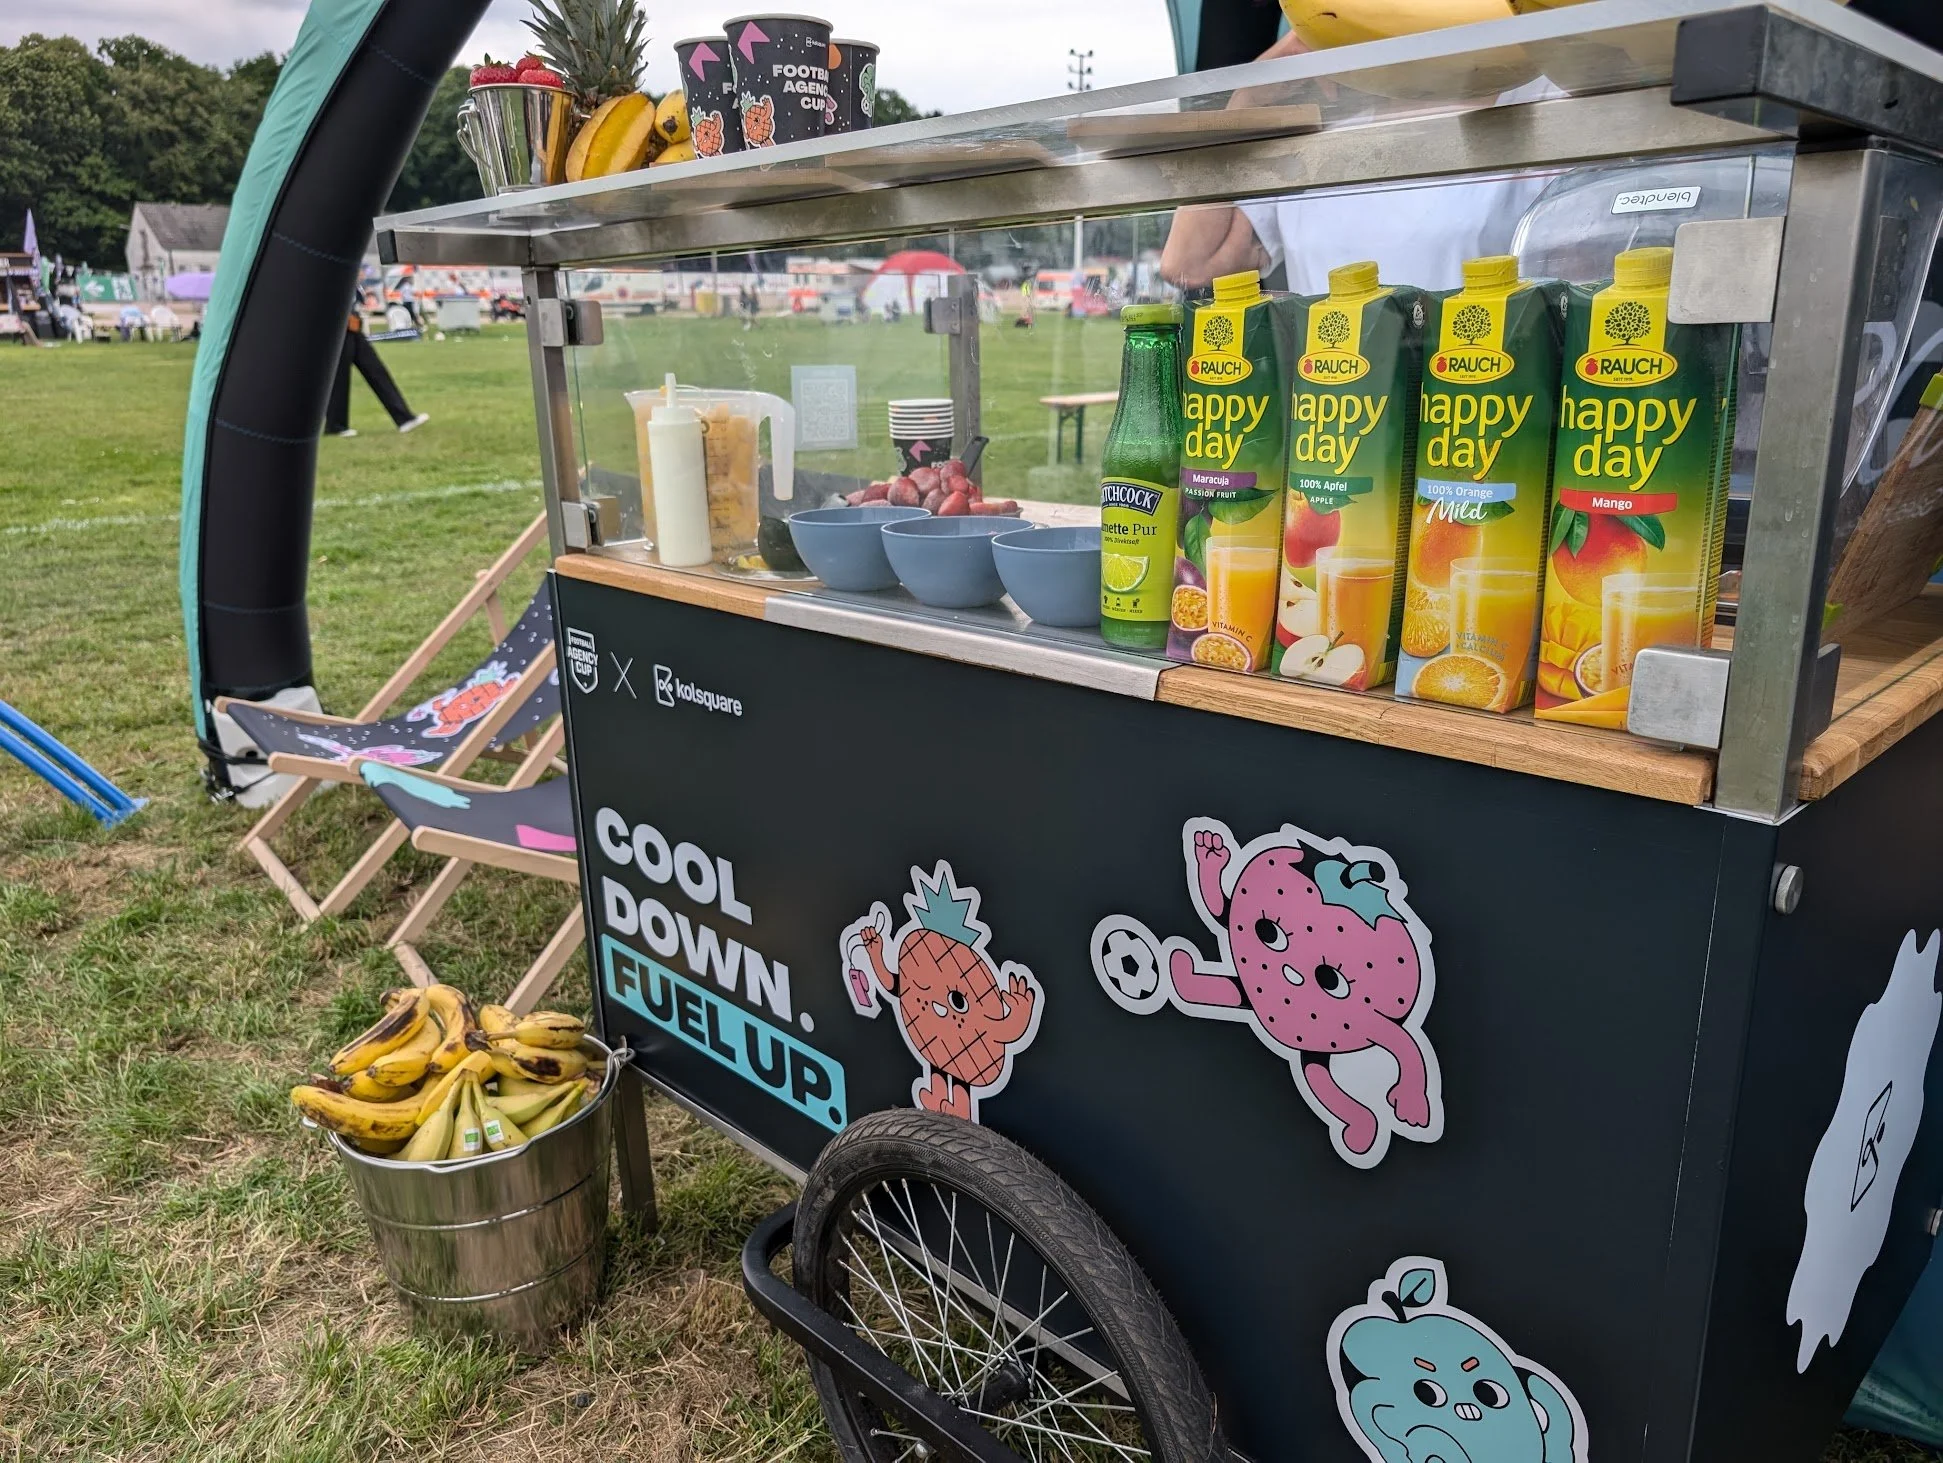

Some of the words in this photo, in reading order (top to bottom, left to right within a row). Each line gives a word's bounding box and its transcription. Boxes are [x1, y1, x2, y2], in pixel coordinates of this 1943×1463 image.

[800, 96, 827, 112] CUP
[1200, 361, 1242, 376] RAUCH
[1313, 359, 1359, 374] RAUCH
[1448, 356, 1502, 373] RAUCH
[1600, 357, 1663, 375] RAUCH
[1560, 384, 1697, 445] happy
[1185, 422, 1245, 470] day
[1295, 424, 1361, 475] day
[1426, 426, 1503, 481] day
[1573, 433, 1664, 491] day
[1192, 473, 1230, 486] Maracuja
[1299, 479, 1322, 489] 100%
[1323, 480, 1347, 492] Apfel
[1185, 487, 1214, 498] PASSION
[1216, 491, 1237, 499] FRUIT
[1427, 484, 1453, 495] 100%
[1455, 486, 1493, 498] Orange
[1310, 496, 1334, 505] APPLE
[1591, 496, 1633, 511] Mango
[1425, 496, 1488, 525] Mild
[1132, 523, 1158, 536] Pur
[1212, 621, 1246, 637] VITAMIN
[567, 645, 599, 667] AGENCY
[575, 660, 593, 676] CUP
[675, 677, 743, 717] kolsquare
[595, 806, 753, 926] COOL
[601, 875, 815, 1033] DOWN.
[610, 945, 737, 1064] FUEL
[744, 1020, 843, 1126] UP.
